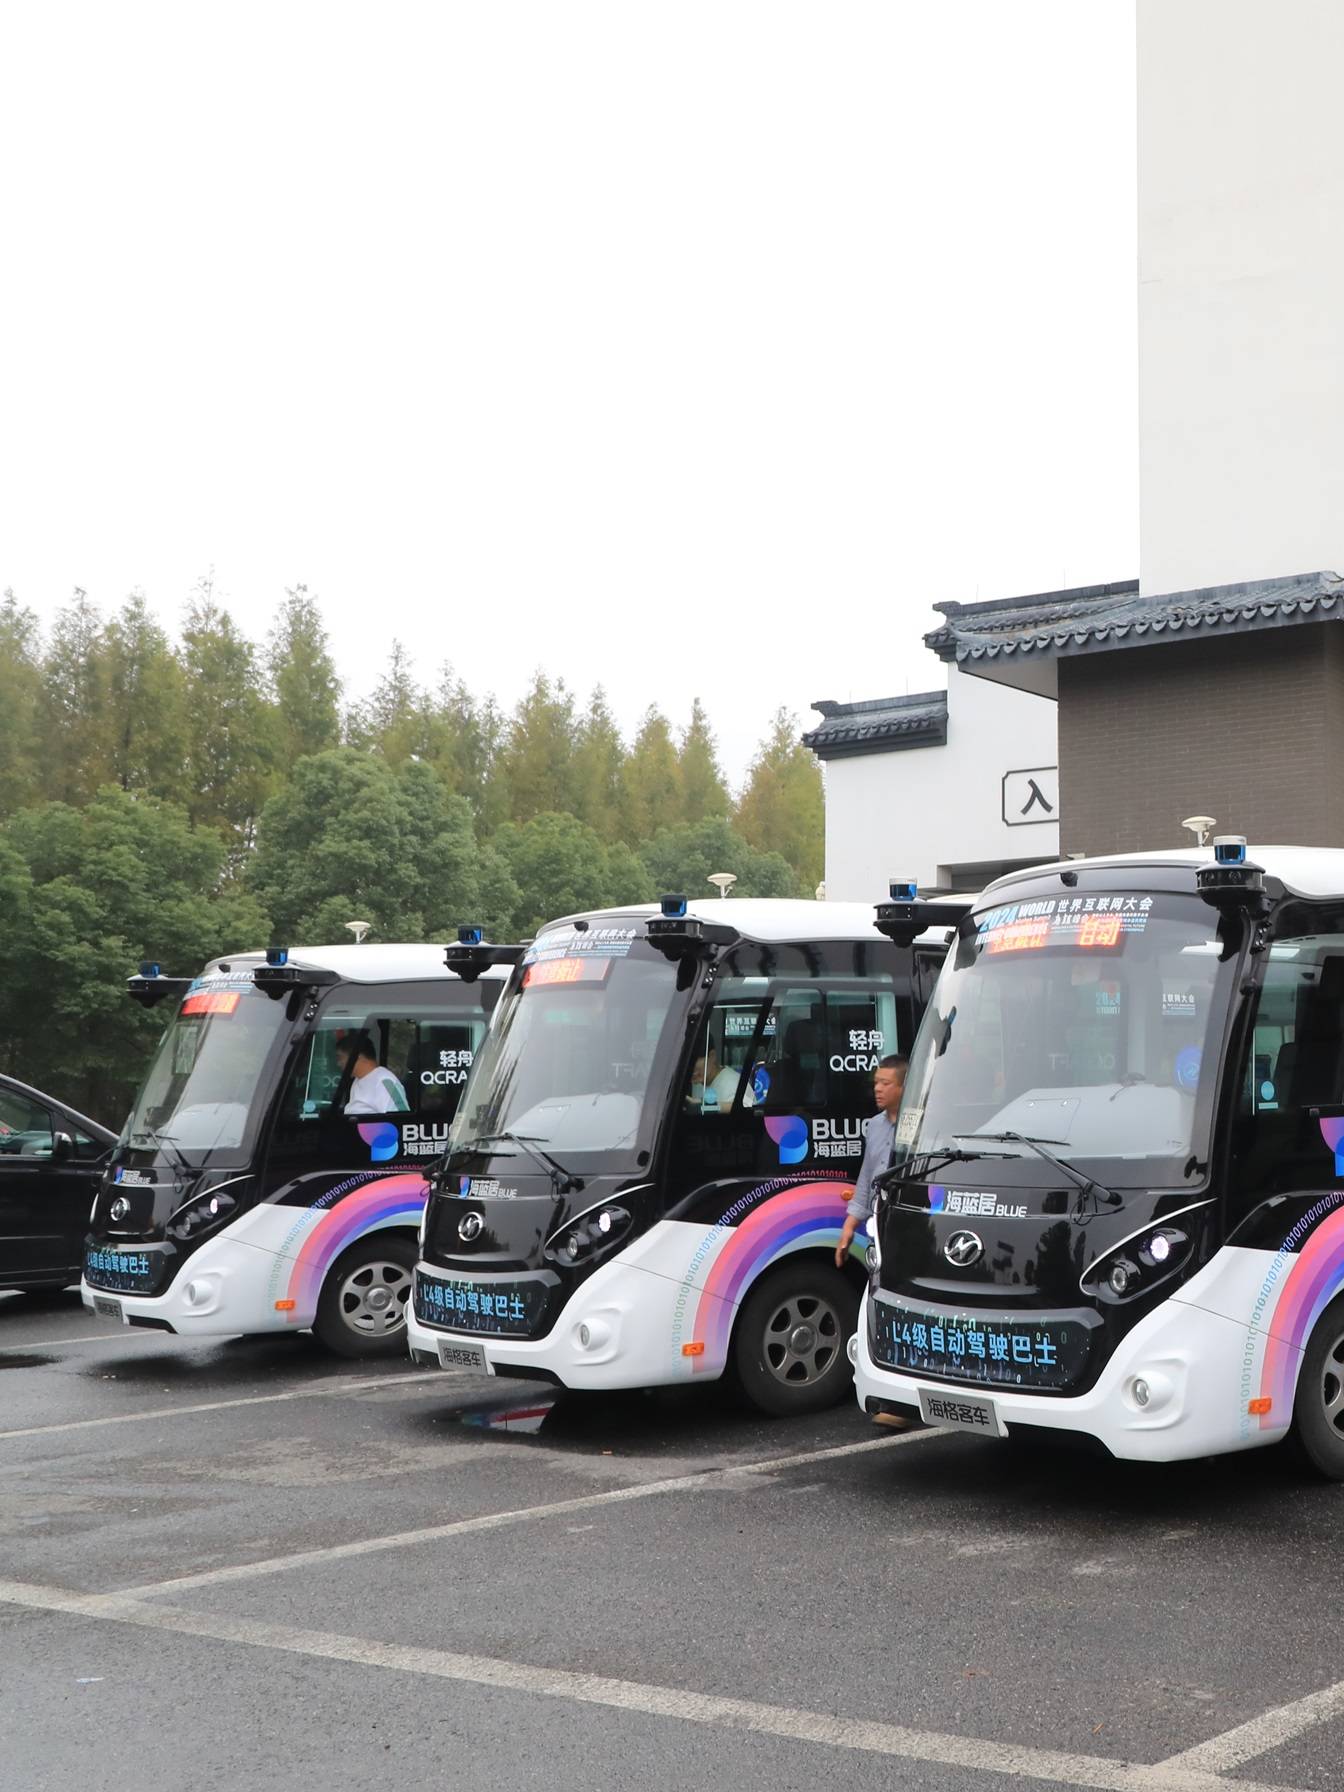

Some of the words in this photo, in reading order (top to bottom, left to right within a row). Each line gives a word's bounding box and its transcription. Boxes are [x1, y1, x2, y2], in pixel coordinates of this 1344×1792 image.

[1020, 778, 1053, 815] 入
[1057, 896, 1154, 913] 世界互联网大会
[978, 905, 1020, 933] 2024
[1018, 900, 1056, 918] WORLD
[849, 1029, 885, 1051] 轻舟
[440, 1049, 474, 1068] 轻舟
[829, 1054, 881, 1073] QCRA
[420, 1069, 468, 1085] QCRA
[402, 1122, 451, 1142] BLU
[813, 1140, 862, 1158] 海蓝居
[944, 1190, 998, 1216] 海蓝居
[995, 1203, 1028, 1218] BLUE
[423, 1283, 525, 1320] L4级自动驾驶巴士
[891, 1319, 1057, 1366] L4级自动驾驶巴士
[927, 1396, 990, 1426] 海格客车
